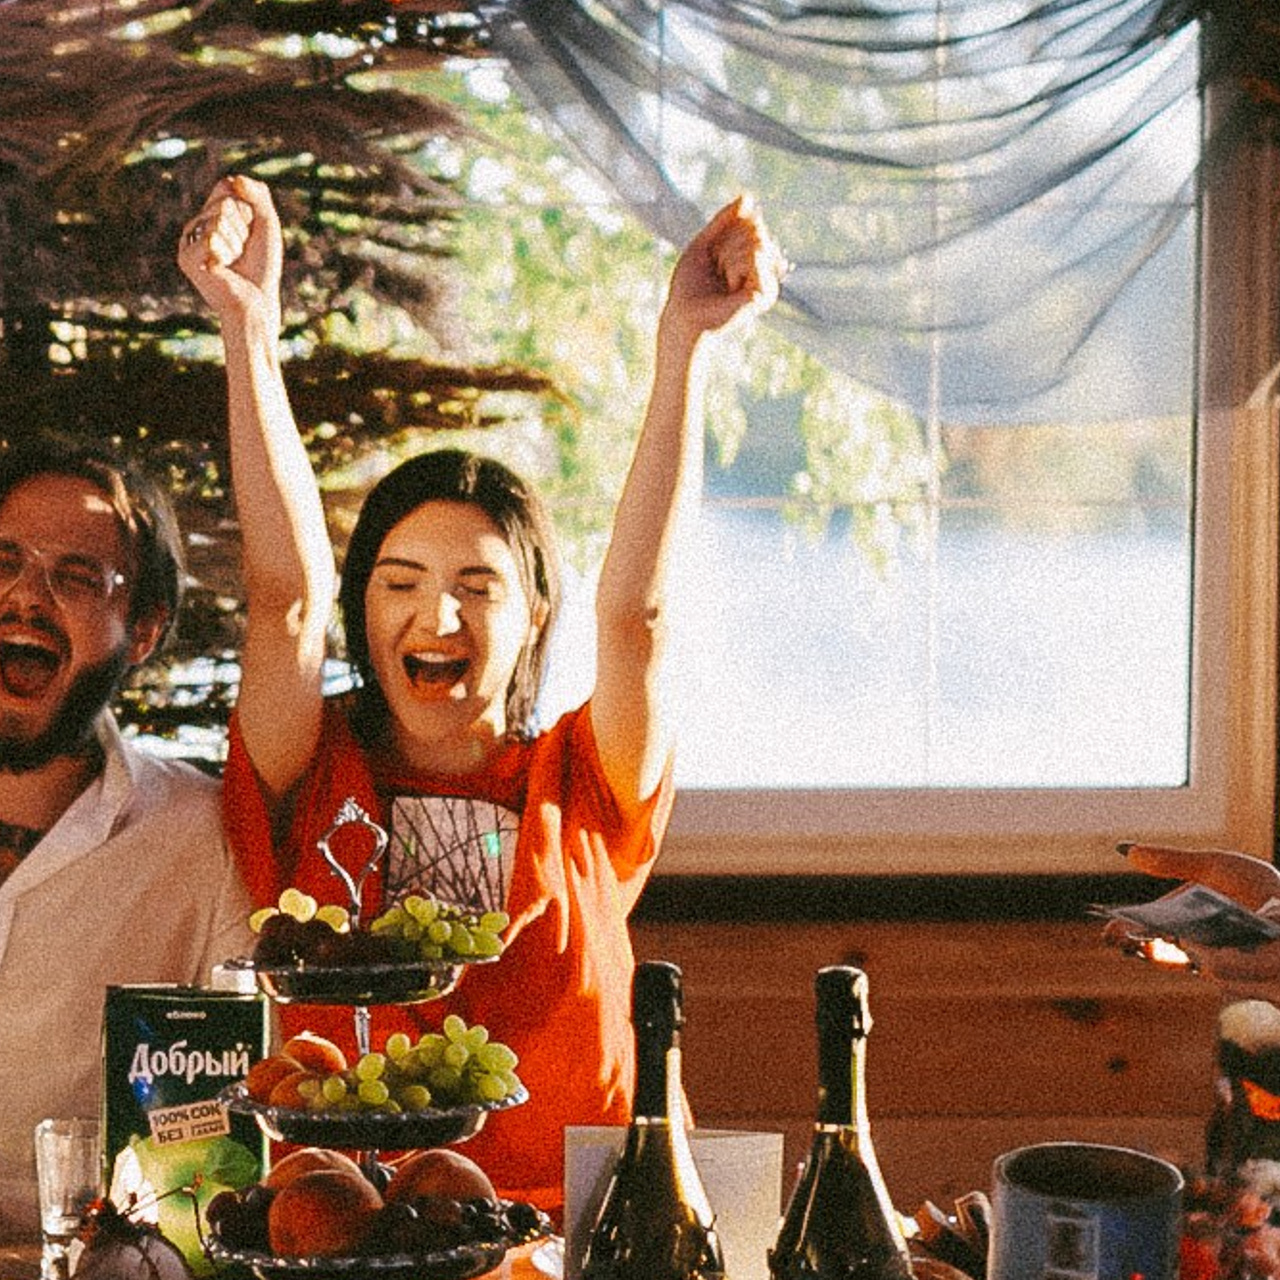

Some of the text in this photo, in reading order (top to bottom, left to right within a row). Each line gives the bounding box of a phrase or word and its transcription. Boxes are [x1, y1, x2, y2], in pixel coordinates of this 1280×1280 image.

[128, 1040, 250, 1084] Добрый
[152, 1103, 221, 1126] 100% СОК
